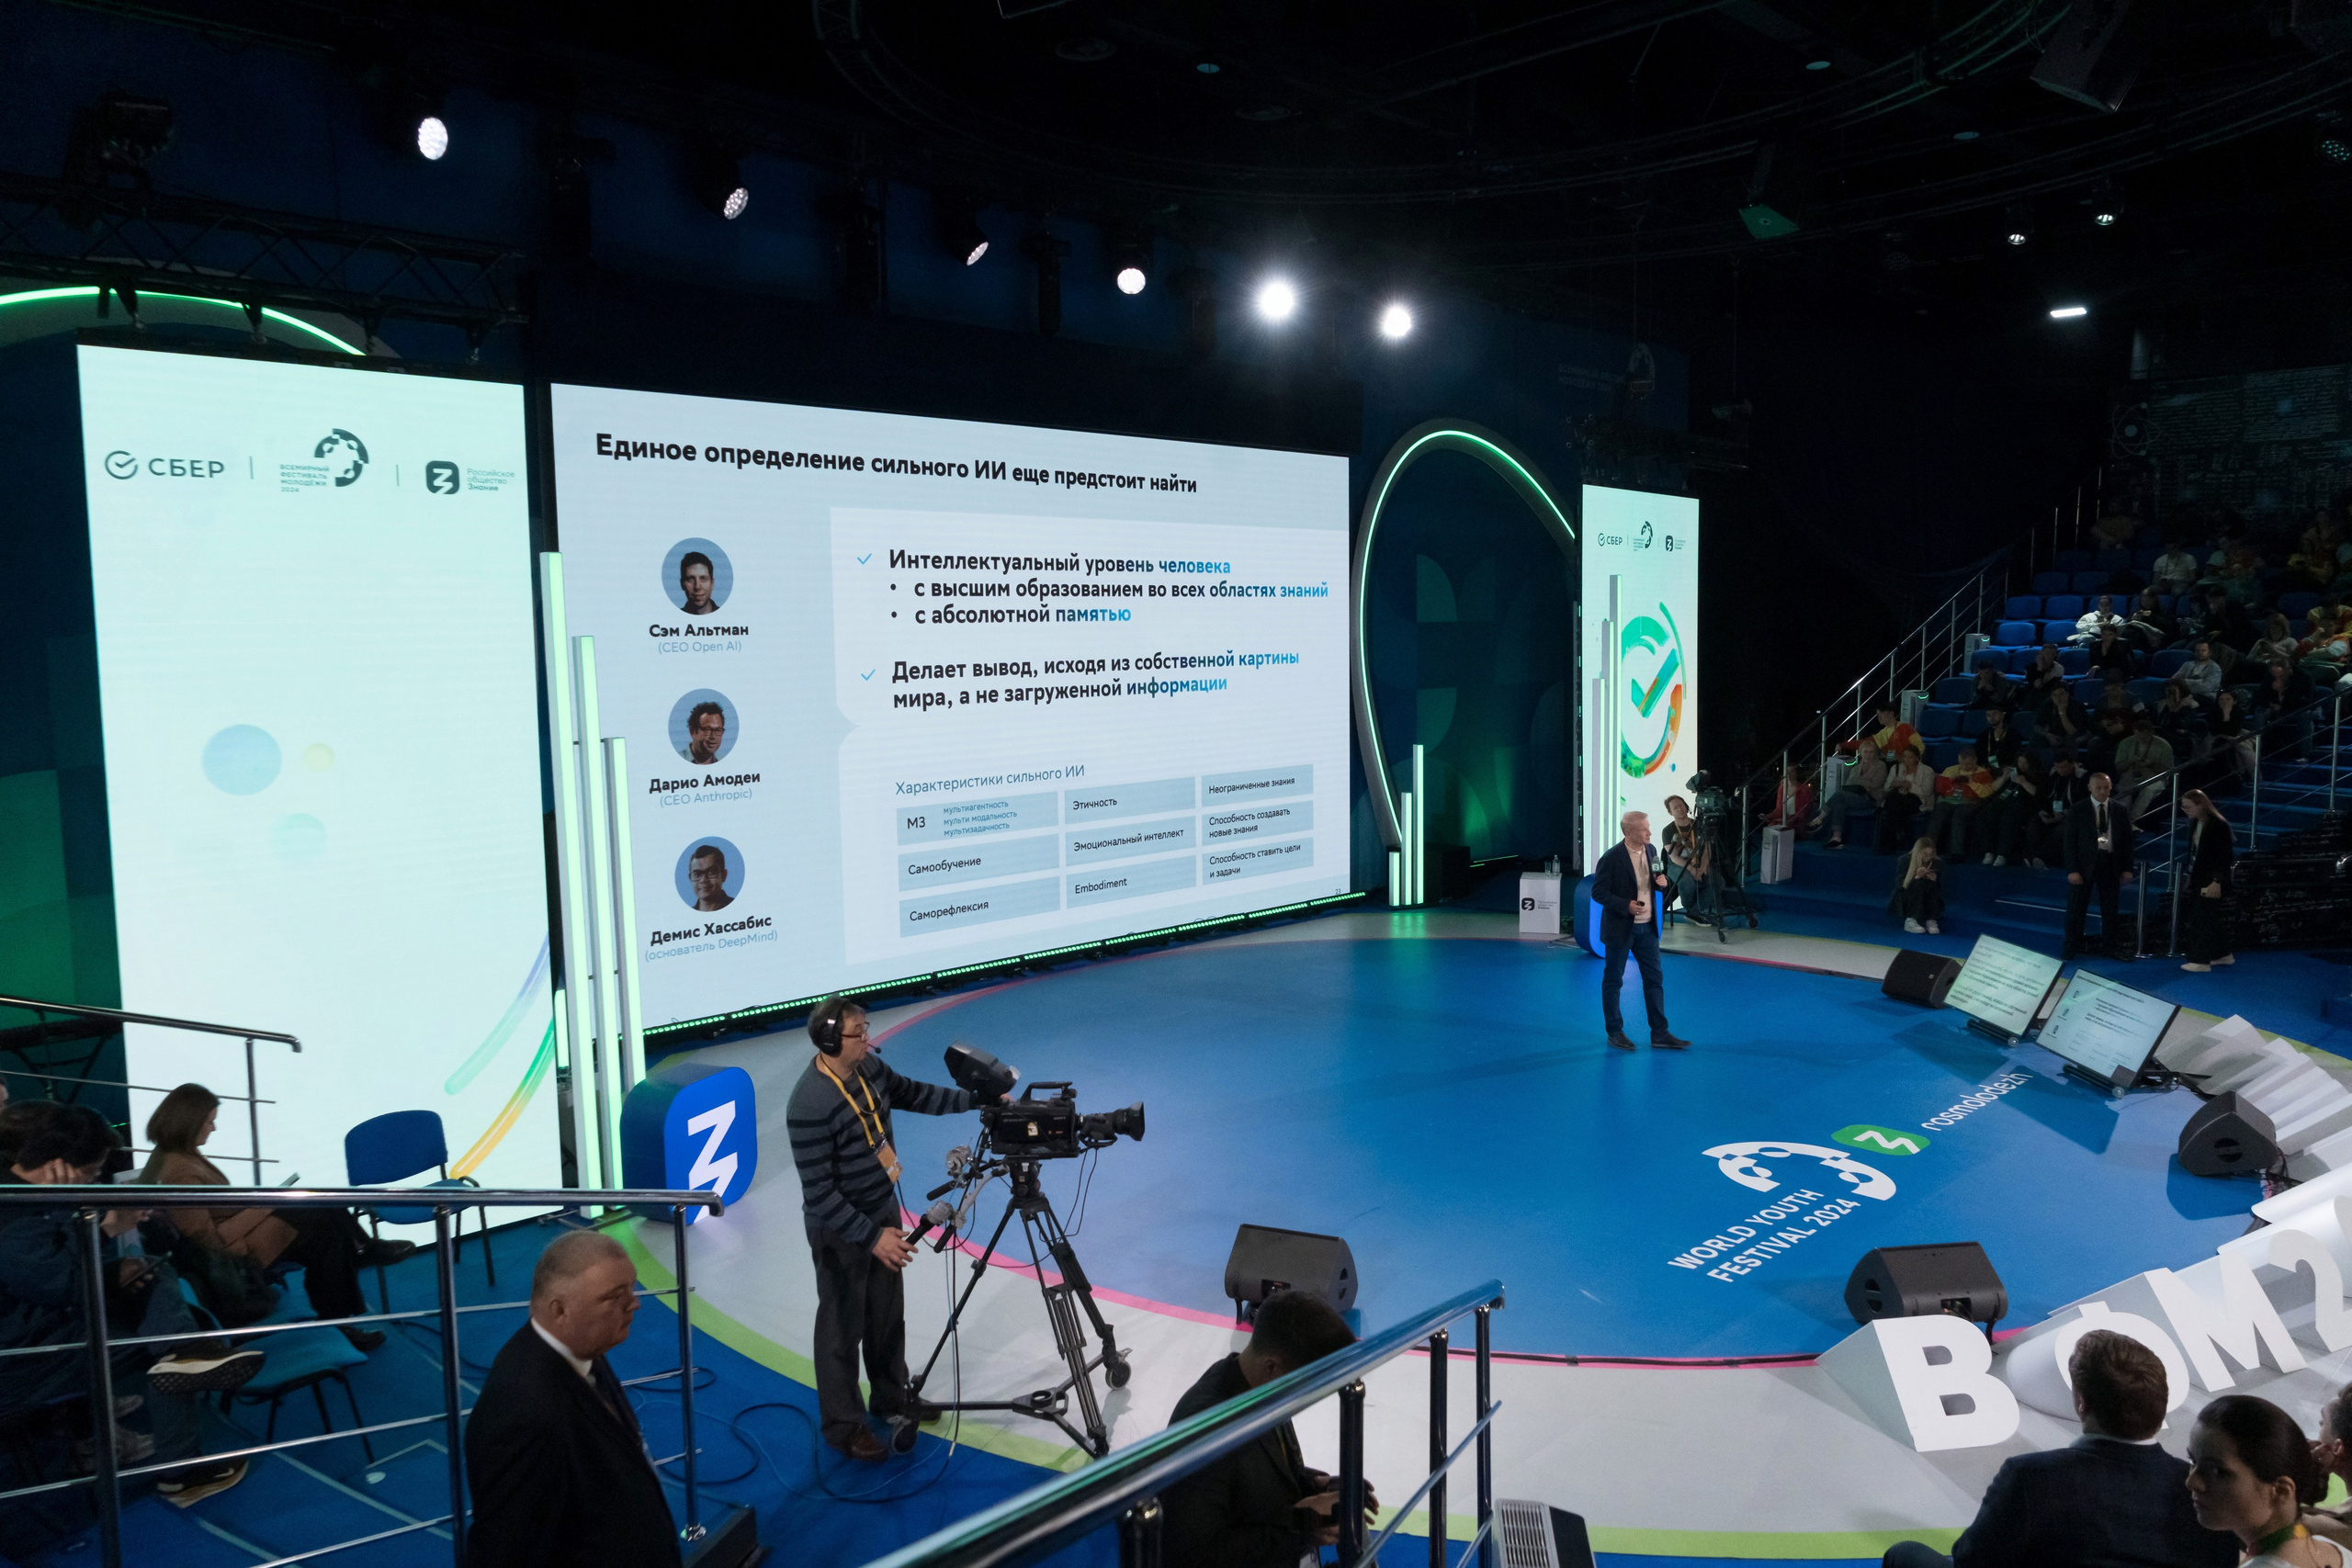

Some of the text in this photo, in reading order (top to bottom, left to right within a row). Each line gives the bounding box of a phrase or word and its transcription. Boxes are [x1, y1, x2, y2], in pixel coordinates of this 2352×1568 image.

[148, 457, 224, 478] СБЕР
[596, 433, 1196, 492] Единое определение сильного ИИ еще предстоит найти
[467, 468, 515, 478] Российское
[467, 476, 507, 485] общество
[468, 482, 499, 491] Знание
[1606, 536, 1623, 546] СБЕР
[889, 549, 1230, 576] Интеллектуальный уровень человека
[914, 577, 1328, 602] с высшим образованием во всех областях знаний
[915, 604, 1131, 624] с абсолютной памятью
[649, 624, 749, 637] Сэм Альтман
[658, 641, 689, 655] (CEO
[692, 641, 723, 654] Open
[892, 649, 1299, 683] Делает вывод, исходя из собственной картины
[894, 676, 1227, 712] мира, а не загруженной информации
[649, 773, 760, 794] Дарио Амодеи
[896, 764, 1084, 796] Характеристики сильного ИИ
[1209, 778, 1295, 794] Неограниченные знания
[660, 787, 752, 808] (CEO Anthropic)
[1073, 798, 1117, 810] Этичность
[943, 801, 1009, 816] мультиагентность
[1209, 808, 1291, 826] Способность создавать
[944, 811, 1018, 827] мульти модальность
[944, 824, 1010, 838] мультизадачность
[1074, 829, 1184, 852] Эмоциональный интеллект
[1209, 825, 1258, 838] новые знания
[1209, 844, 1301, 865] Способность ставить цели
[908, 858, 981, 874] Самообучение
[1216, 867, 1240, 877] задачи
[1075, 878, 1127, 894] Embodiment
[910, 901, 989, 921] Саморефлексия
[650, 915, 772, 947] Демис Хассабис
[645, 930, 777, 963] (основатель DeepMind)
[1920, 1073, 2033, 1132] rosmolodezh
[1667, 1188, 1825, 1270] WORLD YOUTH
[1706, 1198, 1861, 1283] FESTIVAL 2024
